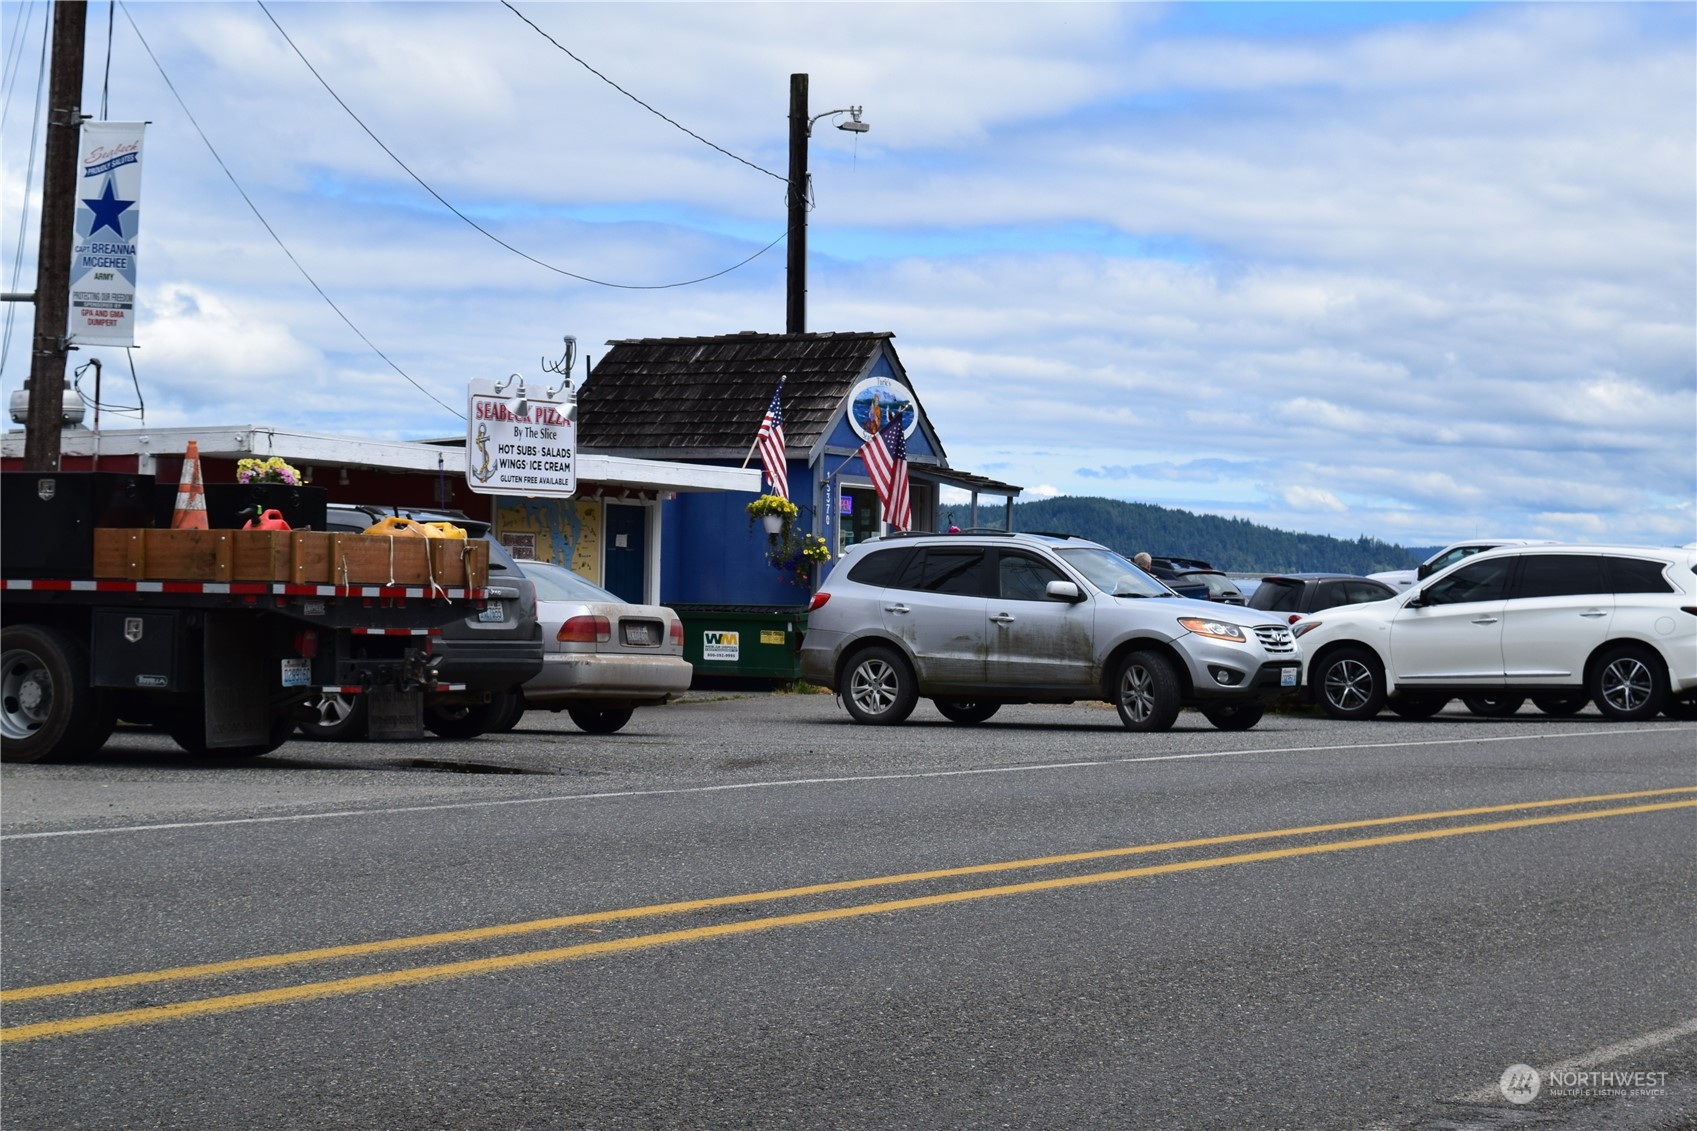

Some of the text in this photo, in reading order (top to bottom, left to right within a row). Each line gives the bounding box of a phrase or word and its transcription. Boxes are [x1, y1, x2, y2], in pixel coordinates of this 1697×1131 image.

[87, 162, 111, 175] PROUDLY
[91, 243, 136, 256] BREANNA
[82, 257, 127, 268] MCGEHEE
[94, 272, 114, 281] ARMY
[73, 291, 133, 302] PROTECTING OUR FREEDOM
[81, 309, 124, 318] GPA AND GMA
[87, 318, 117, 327] DUMPERT
[475, 400, 532, 424] SEAB
[514, 426, 557, 441] By The Slice
[498, 444, 571, 459] HOT SUBS SALADS
[499, 458, 571, 472] WINGS ICE CREAM
[500, 475, 569, 486] GLUTEN FREE AVAILABLE
[705, 633, 738, 645] WM
